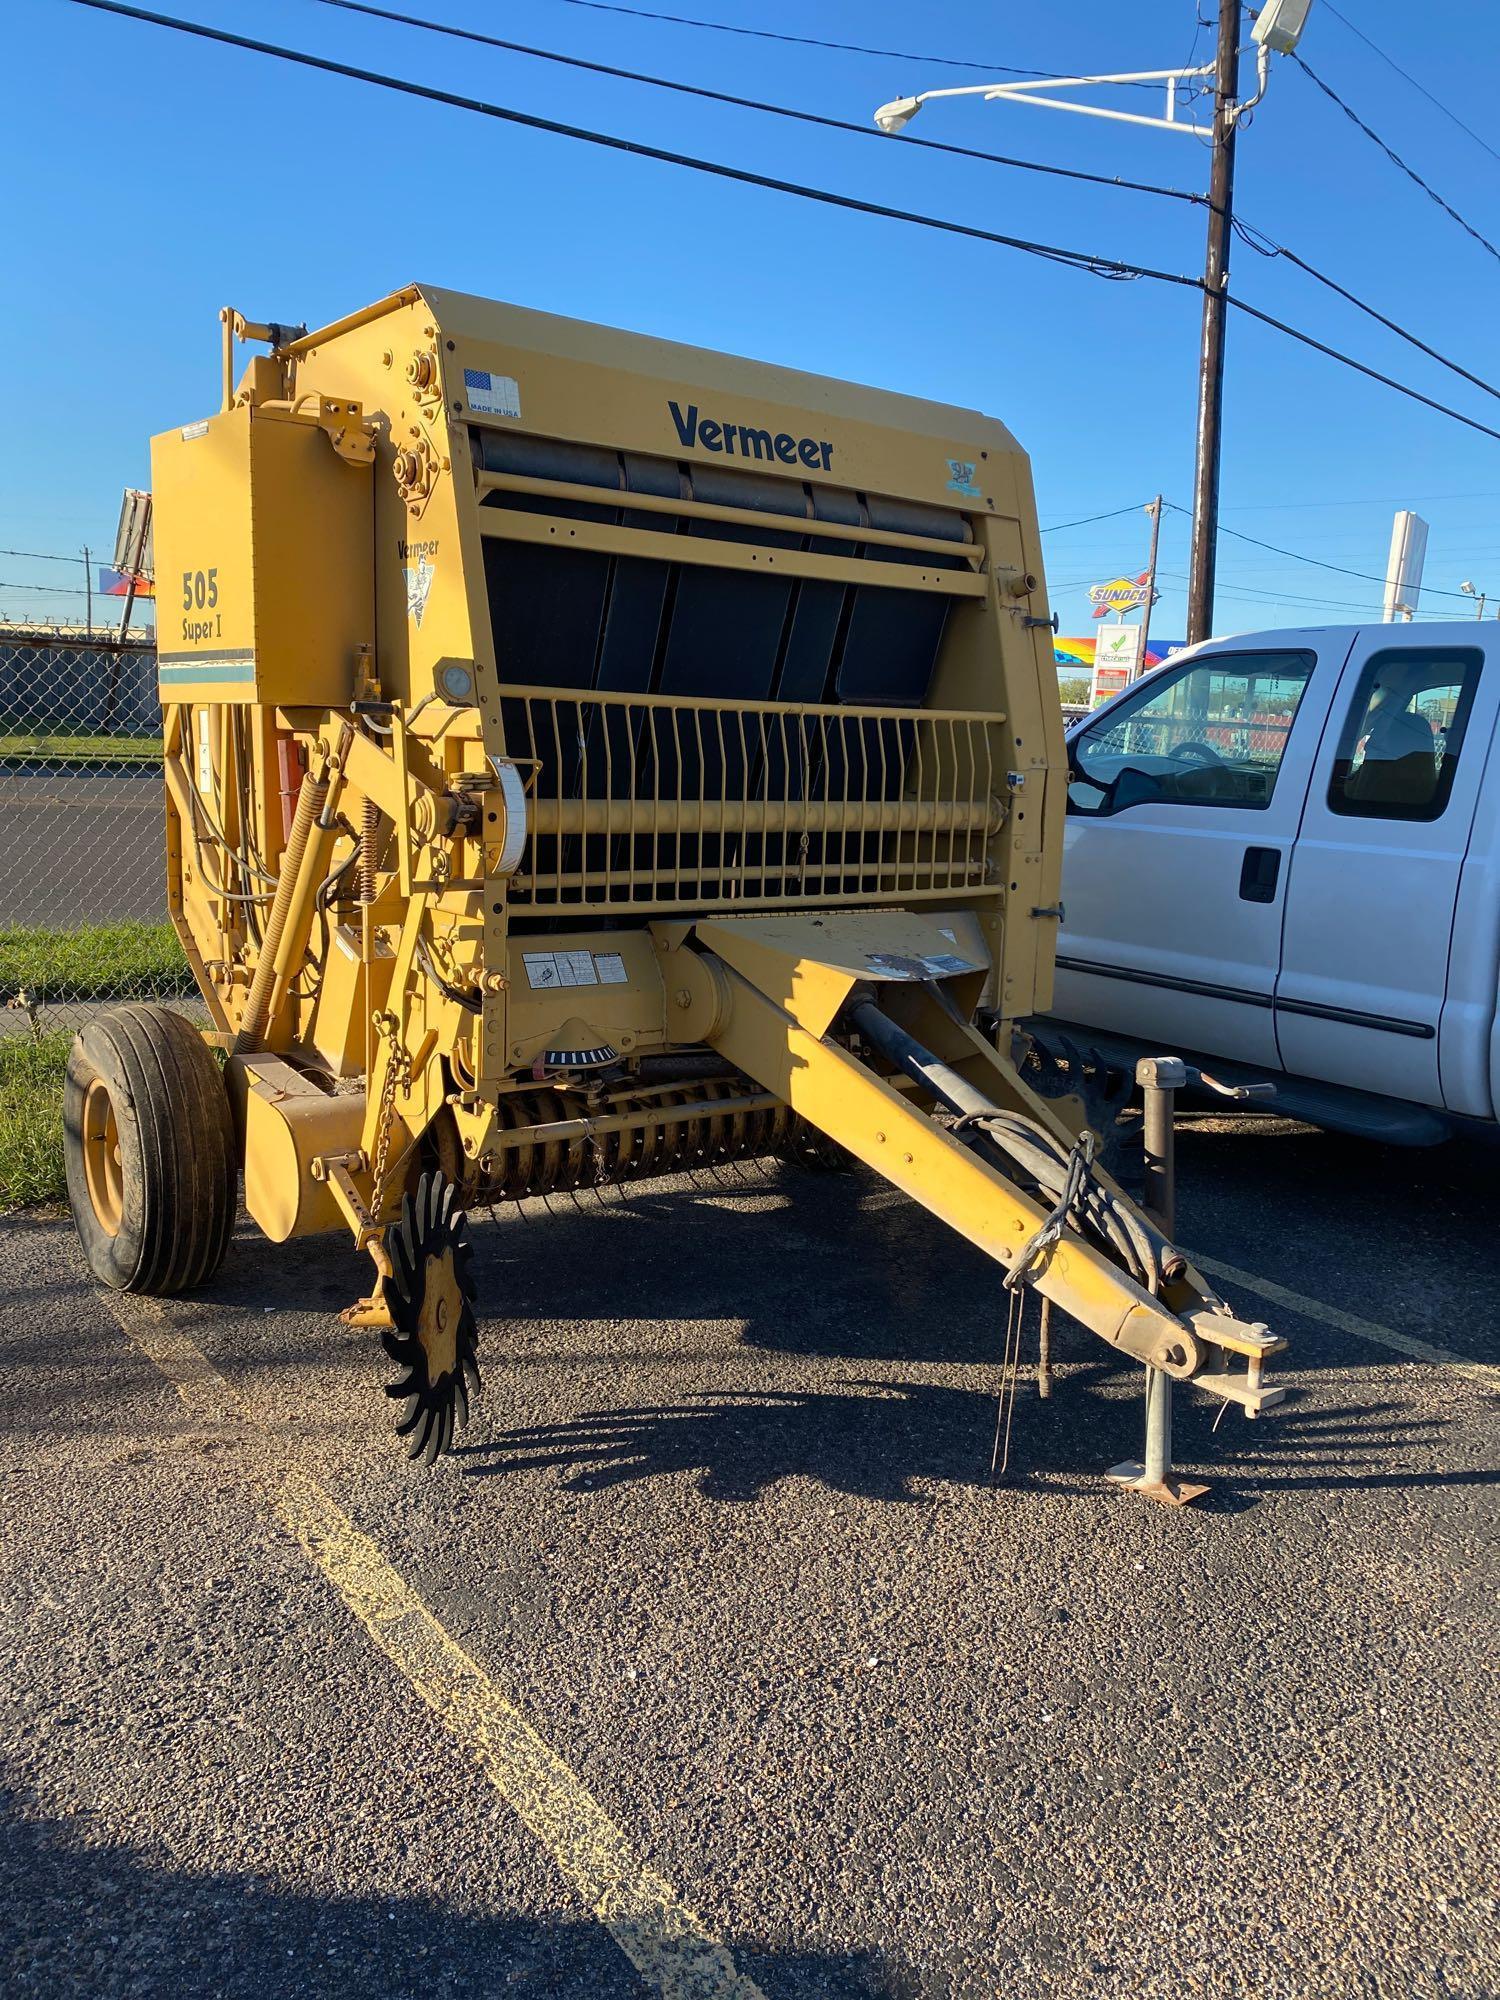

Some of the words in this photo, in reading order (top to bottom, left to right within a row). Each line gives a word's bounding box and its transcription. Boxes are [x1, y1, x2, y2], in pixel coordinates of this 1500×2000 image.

[471, 403, 493, 413] MADE
[504, 409, 518, 417] USA
[667, 400, 834, 472] Vermeer
[183, 567, 218, 611] 505
[1093, 588, 1148, 601] SUNOCO
[182, 618, 213, 645] Super
